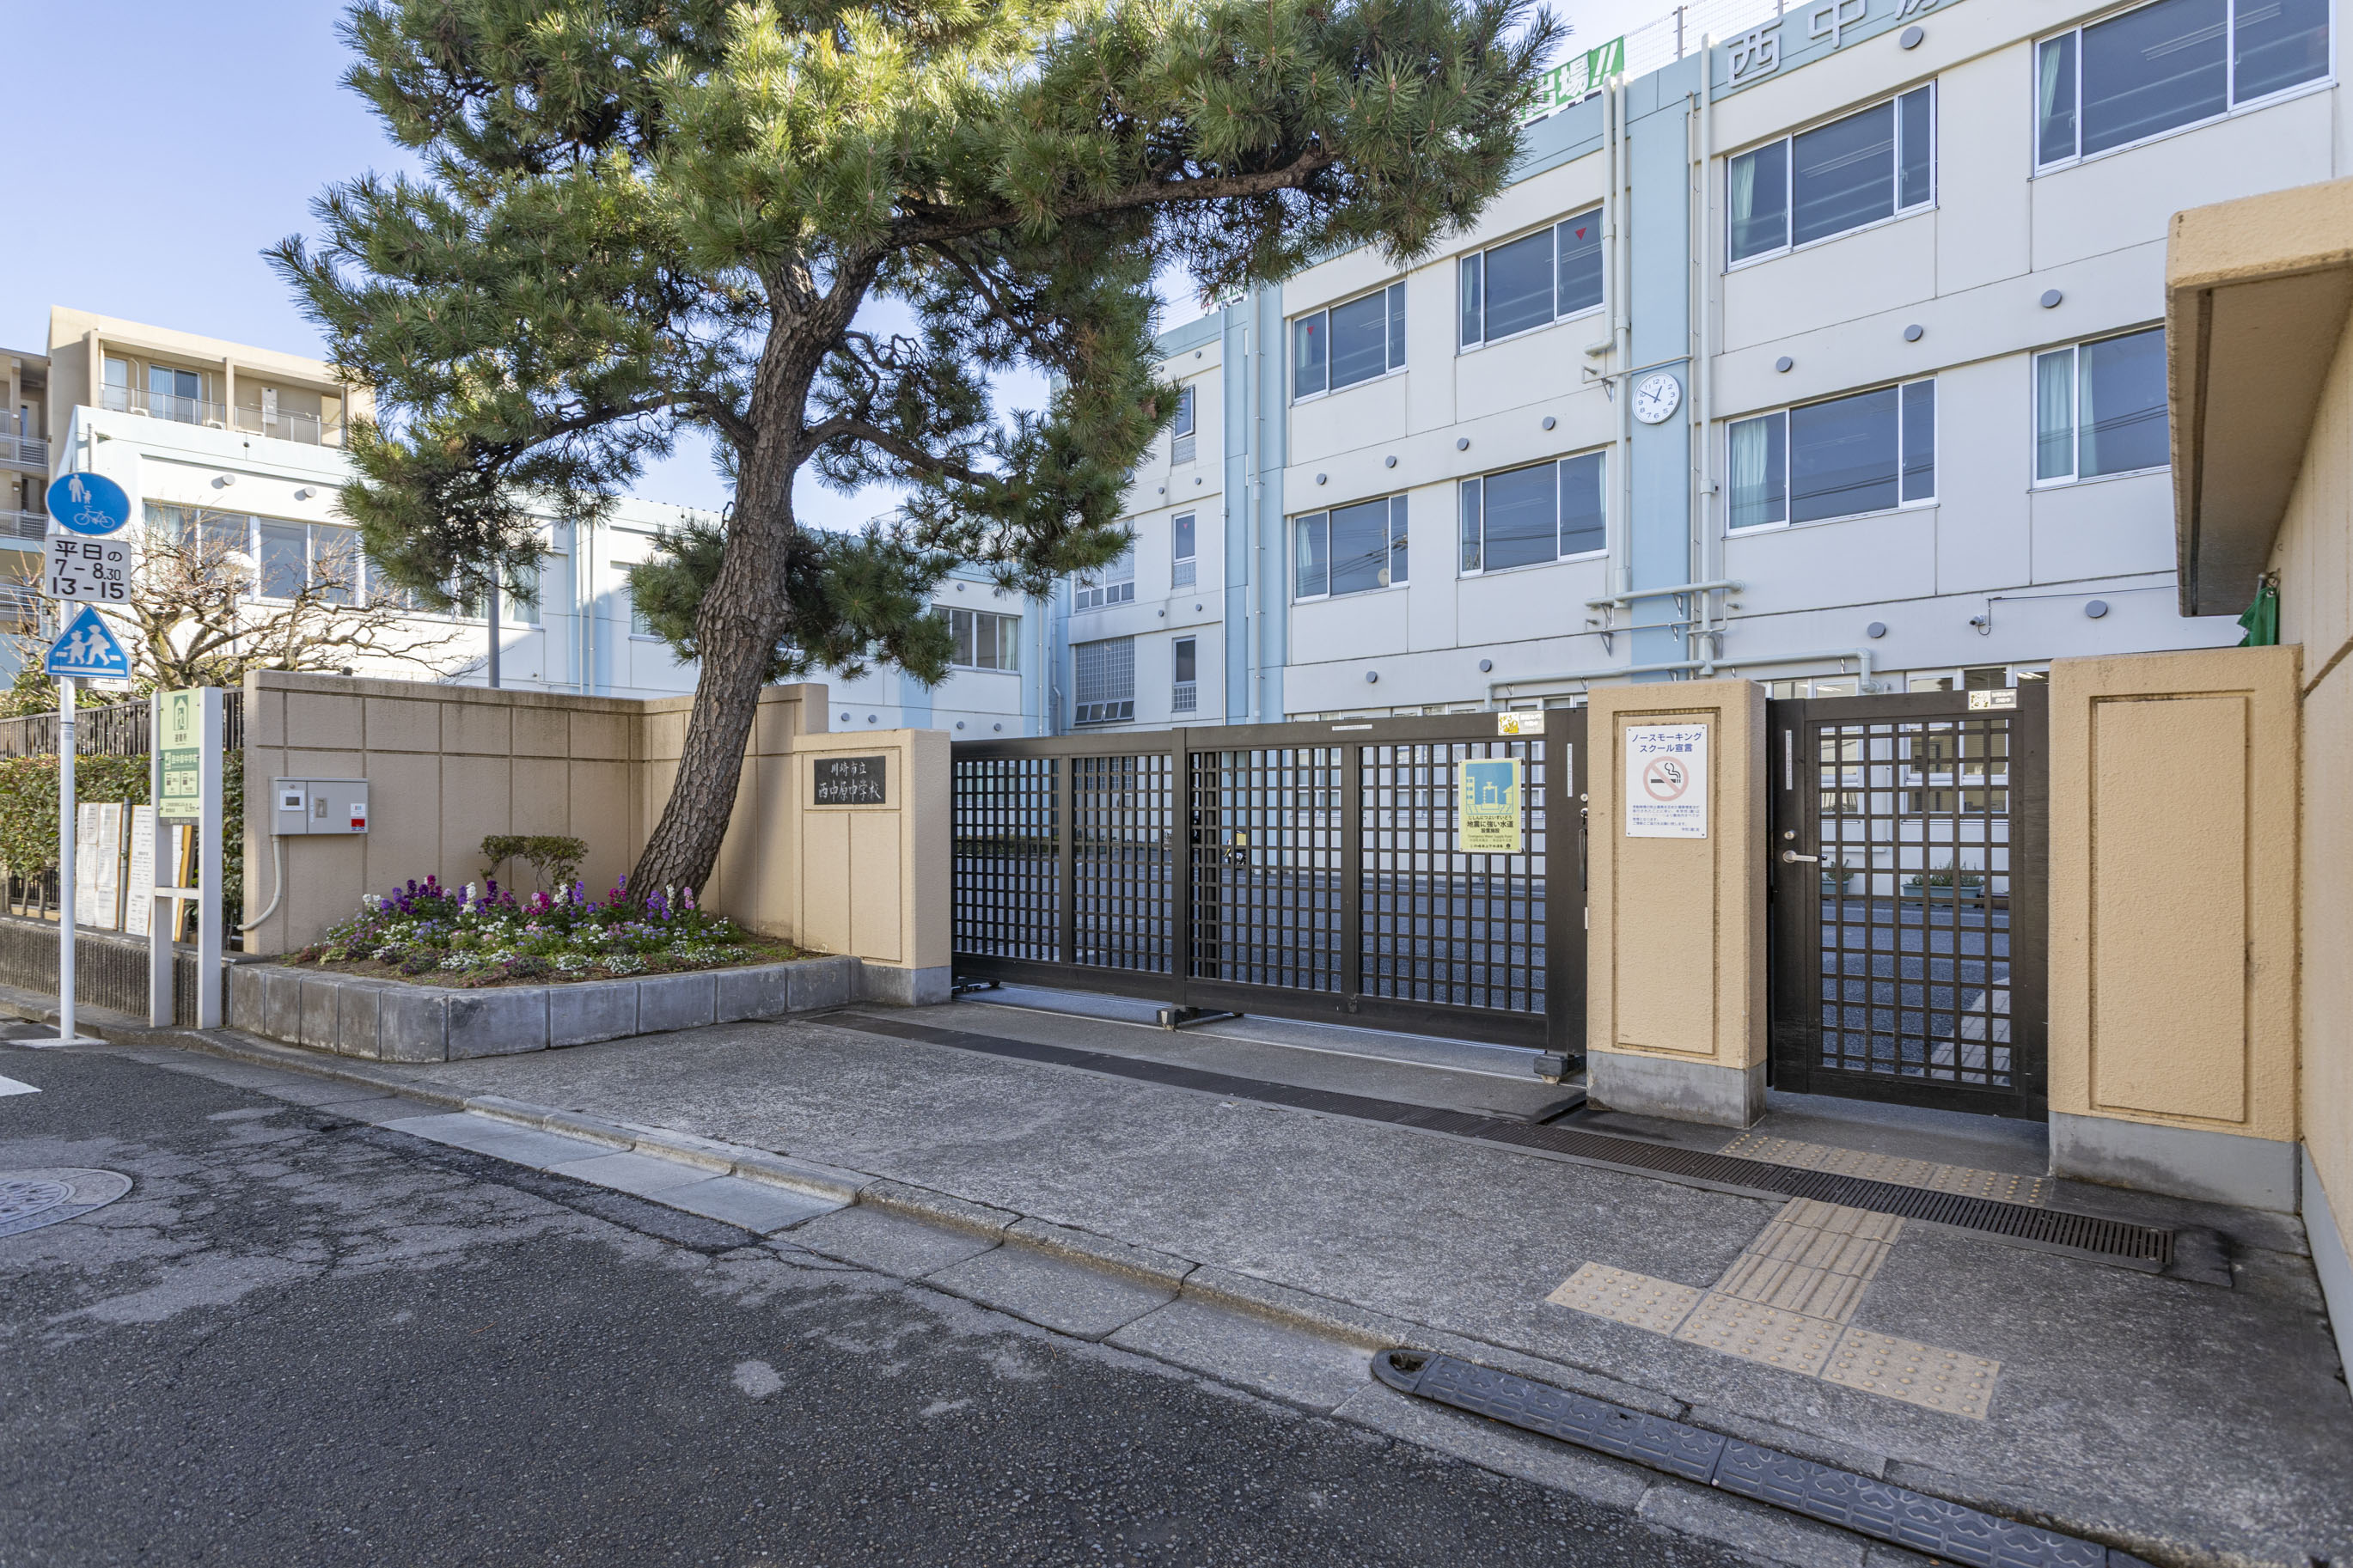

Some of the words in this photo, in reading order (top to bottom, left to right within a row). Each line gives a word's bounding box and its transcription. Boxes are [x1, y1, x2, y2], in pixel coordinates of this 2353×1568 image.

[55, 540, 123, 562] 平日の
[1632, 731, 1702, 742] ノースモーキング
[1640, 743, 1693, 753] スクール宣言
[831, 760, 866, 778] 川崎市立
[818, 778, 882, 802] 西中原中学校
